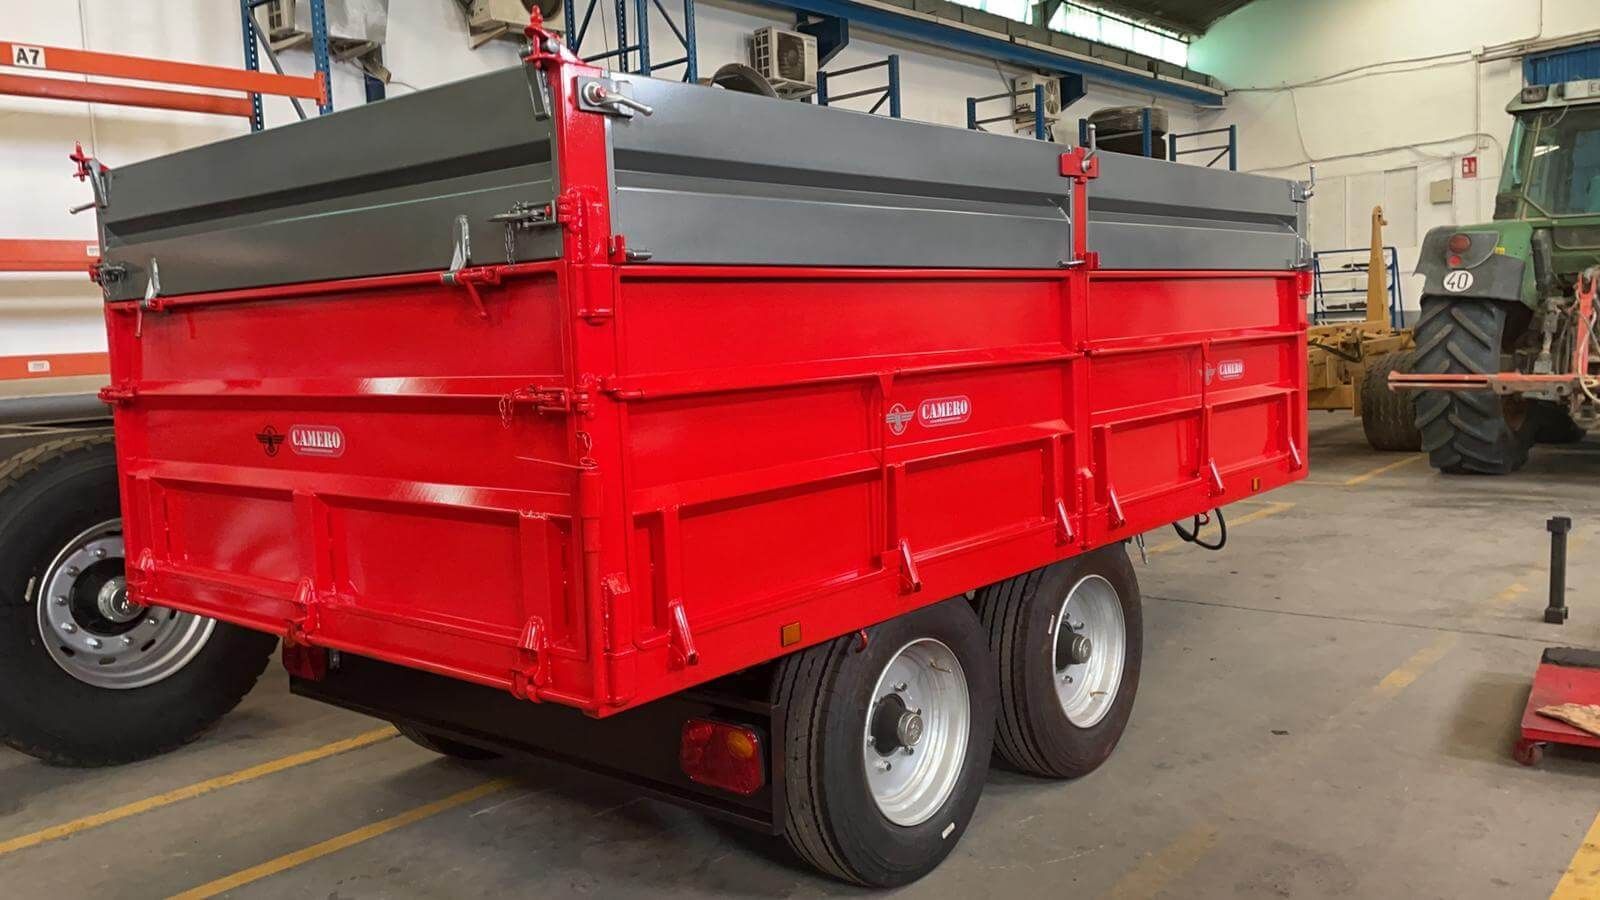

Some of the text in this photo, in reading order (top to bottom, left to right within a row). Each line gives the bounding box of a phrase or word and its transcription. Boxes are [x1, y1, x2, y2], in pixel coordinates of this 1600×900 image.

[16, 47, 39, 65] A7
[1447, 272, 1469, 289] 40
[922, 399, 968, 419] CAMERO
[292, 429, 341, 448] CAMERO
